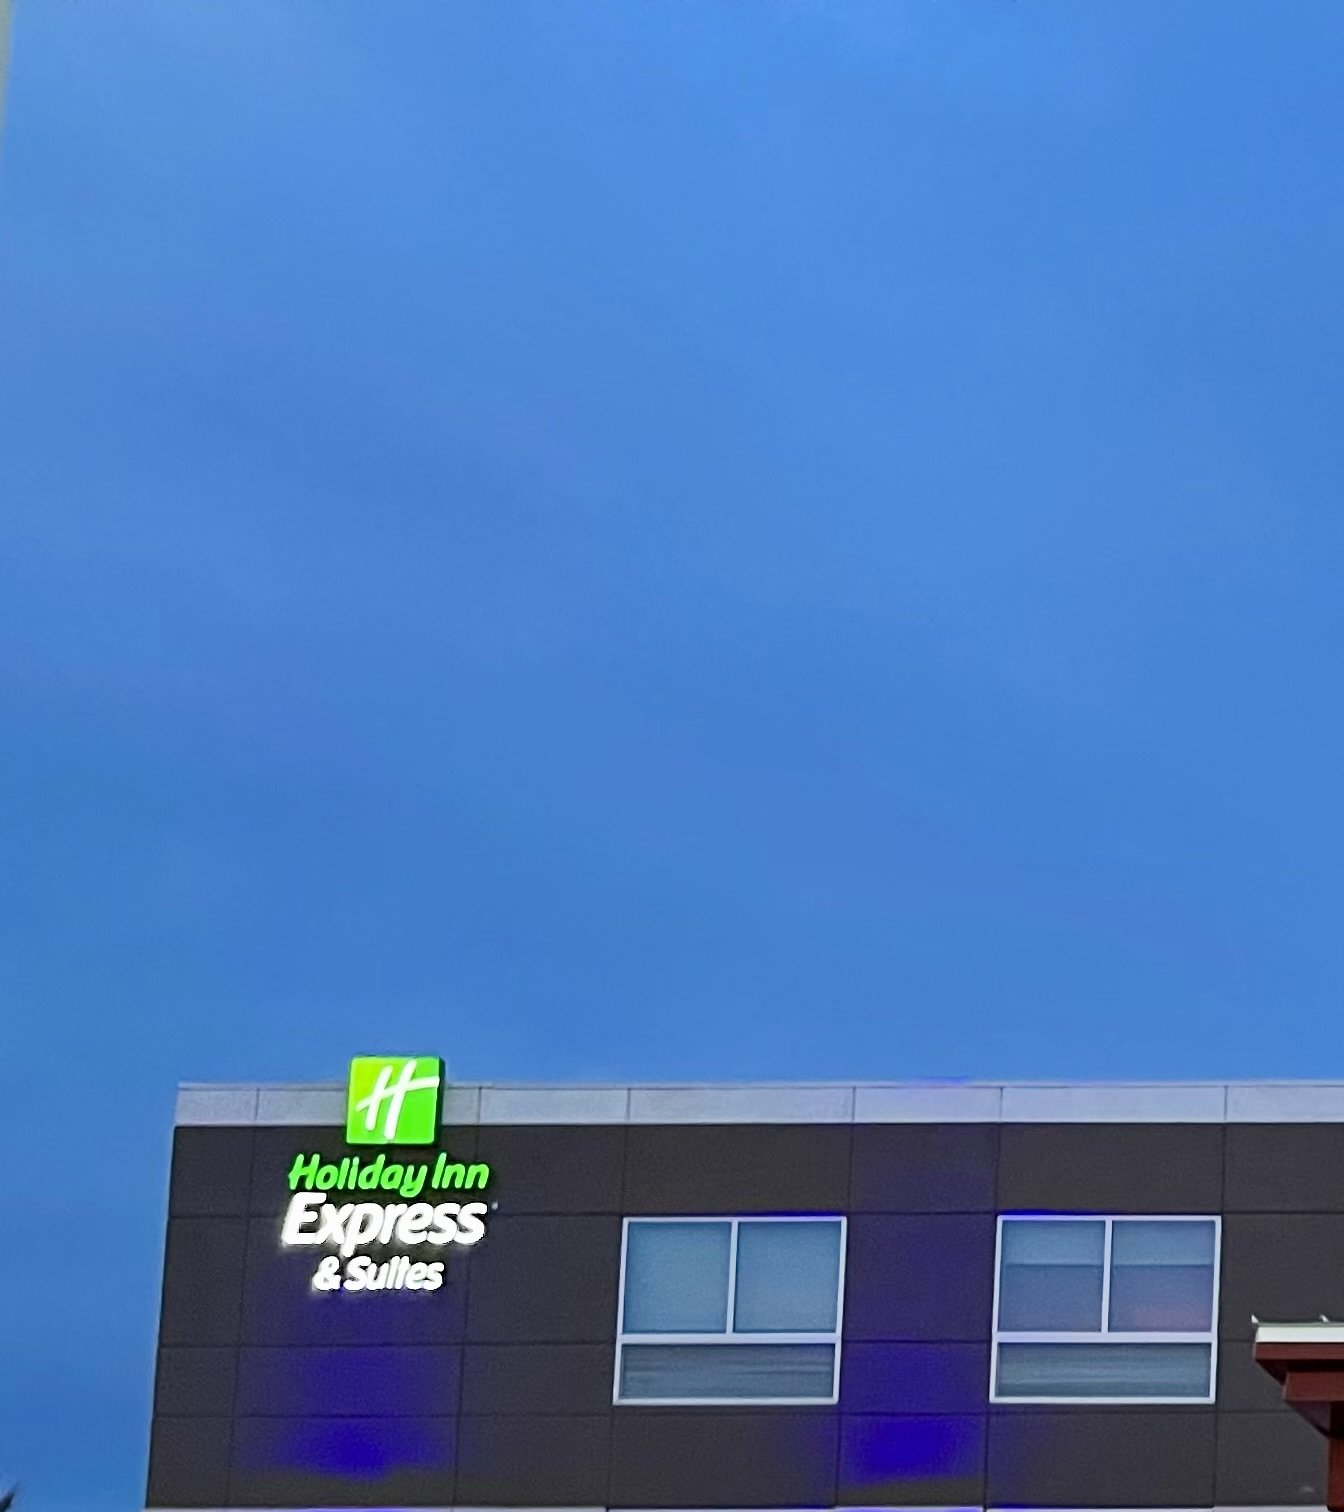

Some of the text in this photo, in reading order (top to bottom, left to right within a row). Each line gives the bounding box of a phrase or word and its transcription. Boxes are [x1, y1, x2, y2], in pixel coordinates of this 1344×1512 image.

[288, 1152, 489, 1198] Holiday Inn
[281, 1191, 488, 1258] Express
[311, 1255, 445, 1291] & Suites
